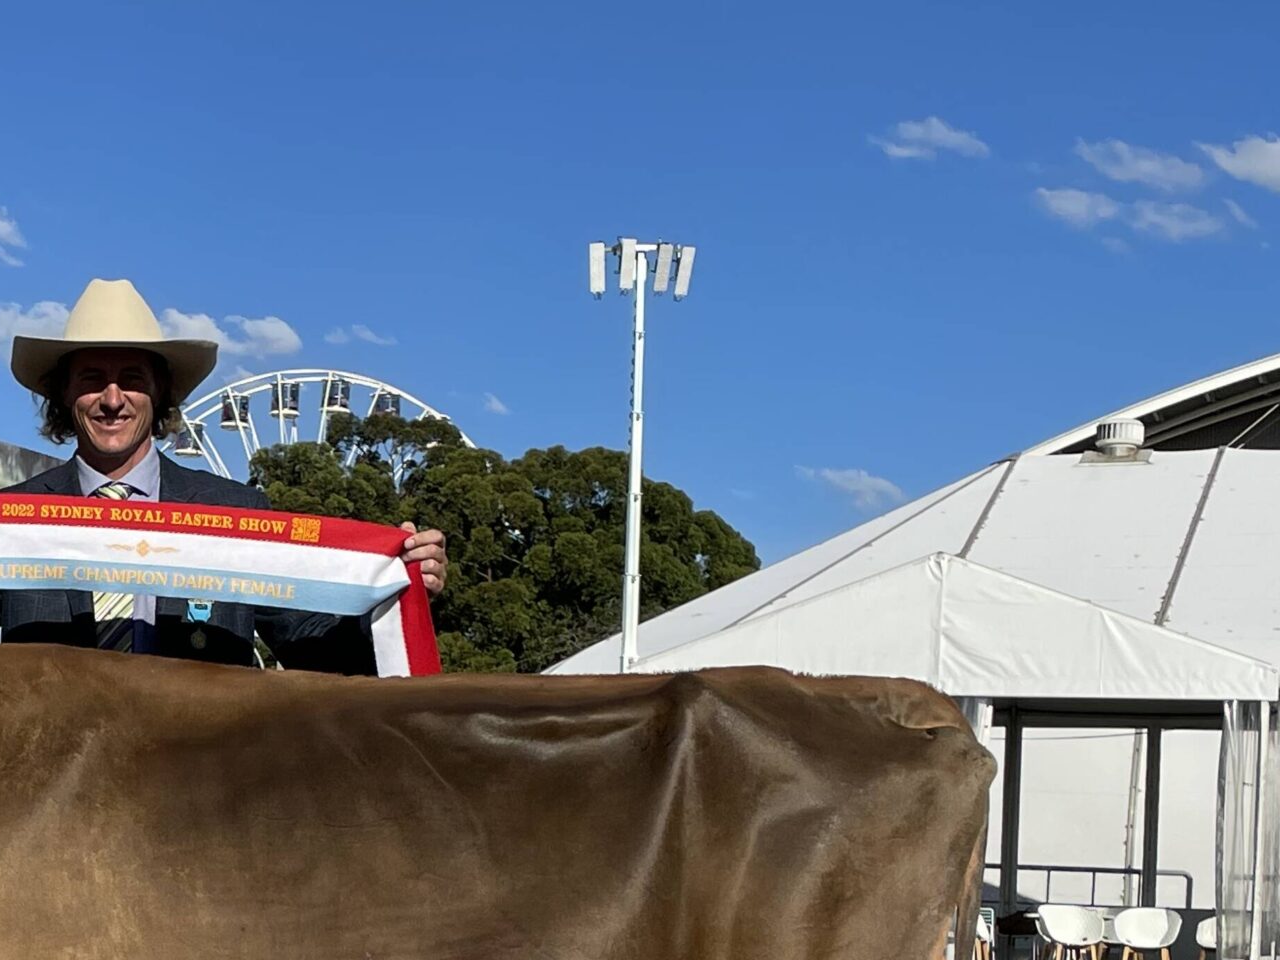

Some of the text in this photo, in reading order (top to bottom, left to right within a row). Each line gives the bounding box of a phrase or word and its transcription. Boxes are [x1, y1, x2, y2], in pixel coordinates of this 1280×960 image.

[2, 503, 288, 535] 2022 SYDNEY ROYAL EASTER SHOW
[72, 566, 169, 586] CHAMPION
[172, 572, 227, 591] DAIRY
[230, 577, 297, 600] FEMALE
